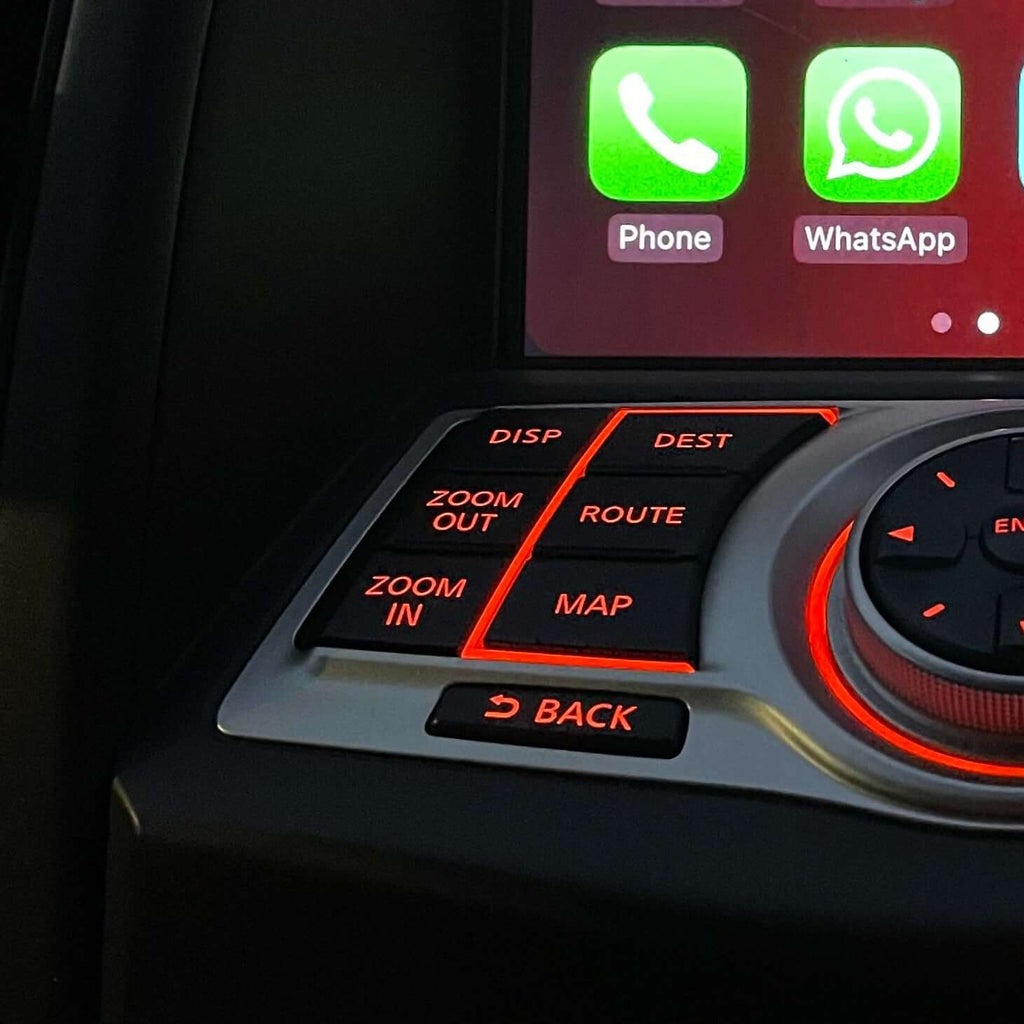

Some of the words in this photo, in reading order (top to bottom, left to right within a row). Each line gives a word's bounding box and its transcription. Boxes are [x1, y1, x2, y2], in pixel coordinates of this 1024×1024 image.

[619, 224, 712, 251] Phone
[804, 225, 956, 257] WhatsApp
[489, 428, 563, 445] DISP
[653, 433, 733, 449] DEST
[426, 490, 524, 509] ZOOM
[432, 513, 498, 533] OUT
[579, 505, 687, 525] ROUTE
[364, 575, 467, 599] ZOOM
[385, 602, 424, 627] IN
[554, 593, 634, 617] MAP
[533, 698, 638, 732] BACK
